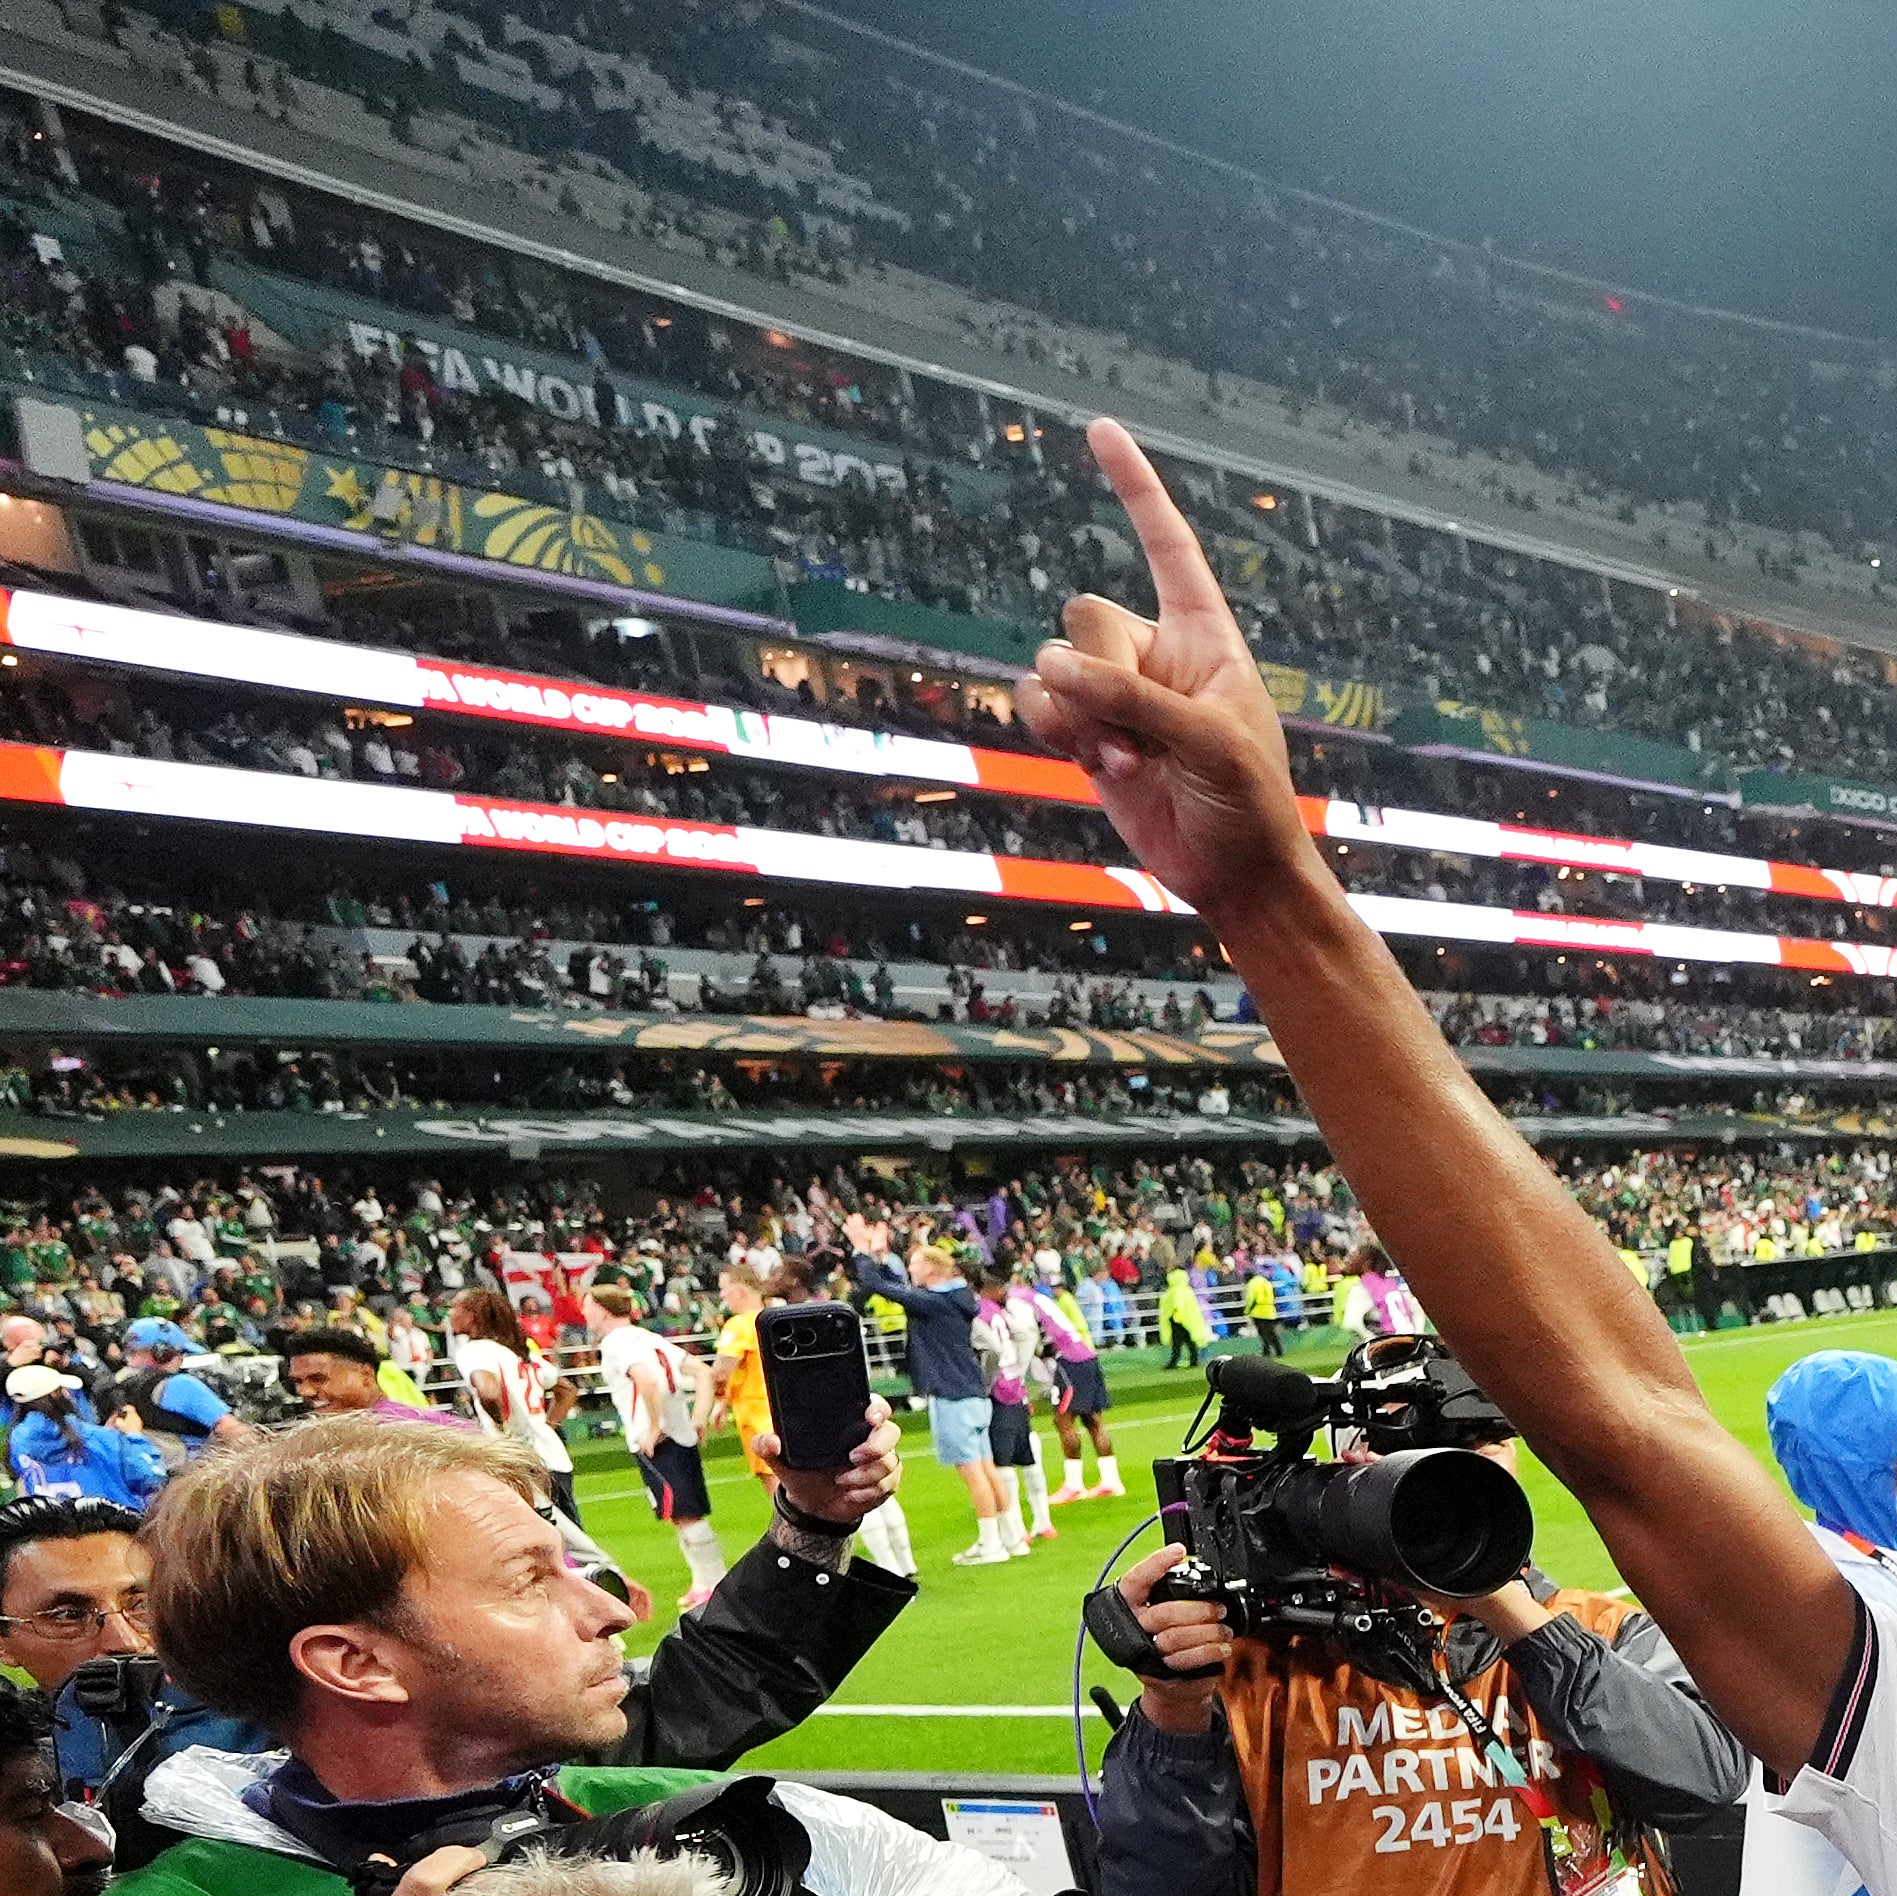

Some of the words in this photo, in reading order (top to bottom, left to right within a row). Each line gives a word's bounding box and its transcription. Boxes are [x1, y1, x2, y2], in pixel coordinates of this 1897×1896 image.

[452, 676, 571, 721] WORLD
[571, 691, 634, 728] CUP
[489, 810, 605, 849] WORLD
[605, 823, 666, 854] CUP
[1307, 1737, 1563, 1806] PARTNR
[1371, 1797, 1522, 1854] 2454
